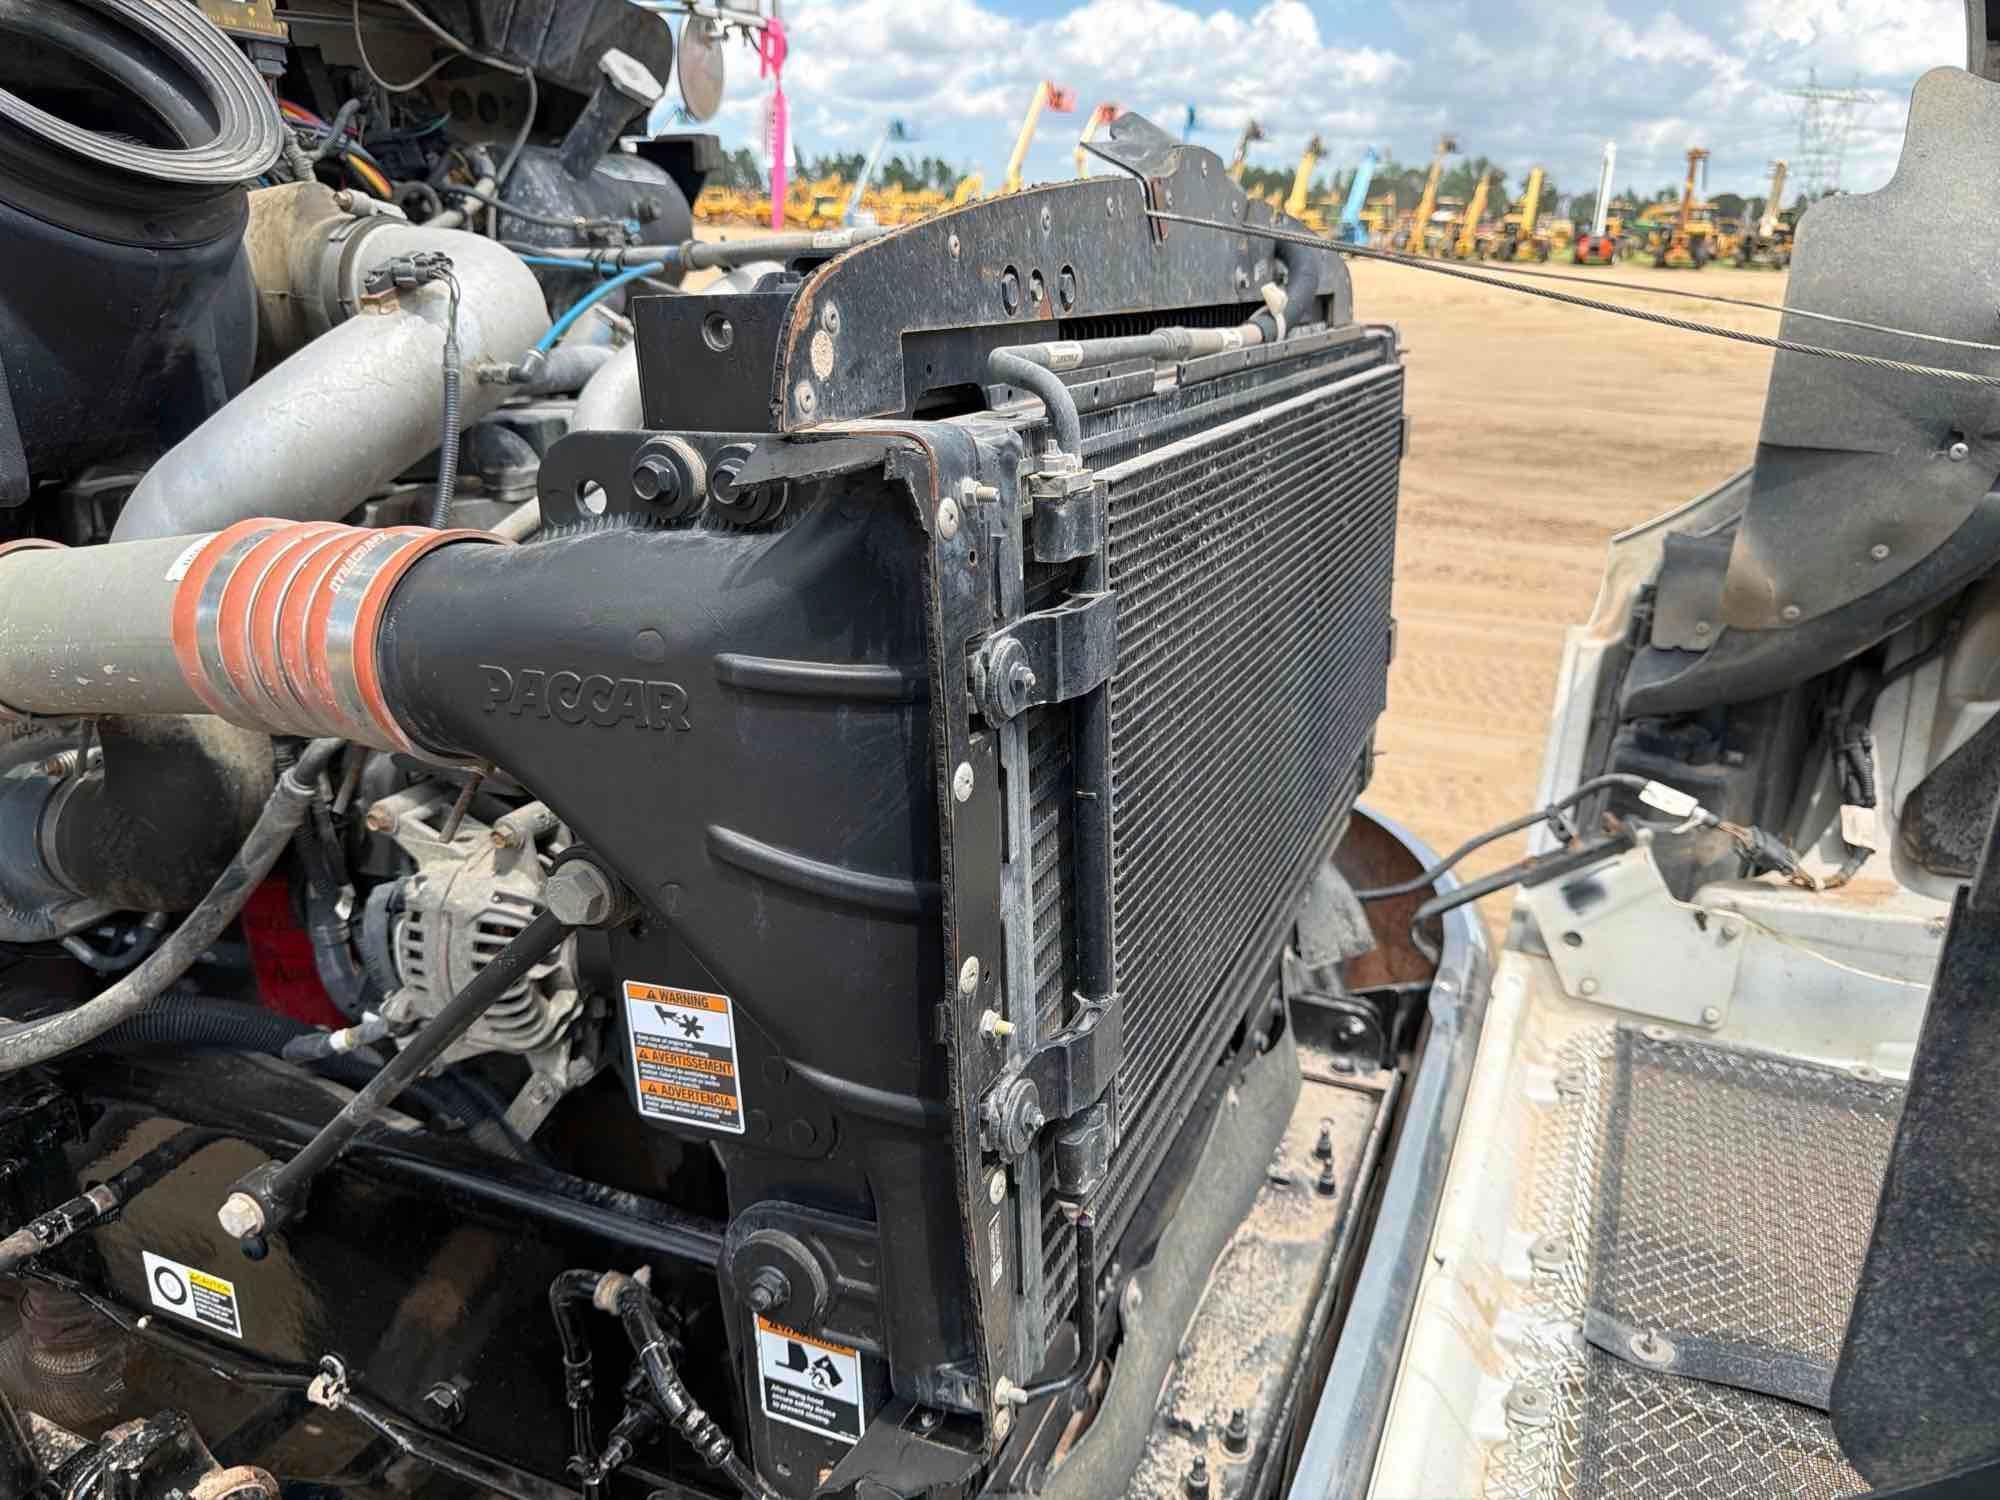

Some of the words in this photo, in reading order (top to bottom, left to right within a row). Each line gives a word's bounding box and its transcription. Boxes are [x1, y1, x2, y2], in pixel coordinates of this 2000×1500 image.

[480, 664, 691, 731] PACCAR
[660, 989, 709, 1008] WARNING
[652, 1051, 732, 1073] AVERTISSEMENT
[661, 1085, 732, 1106] ADVERTENCIA
